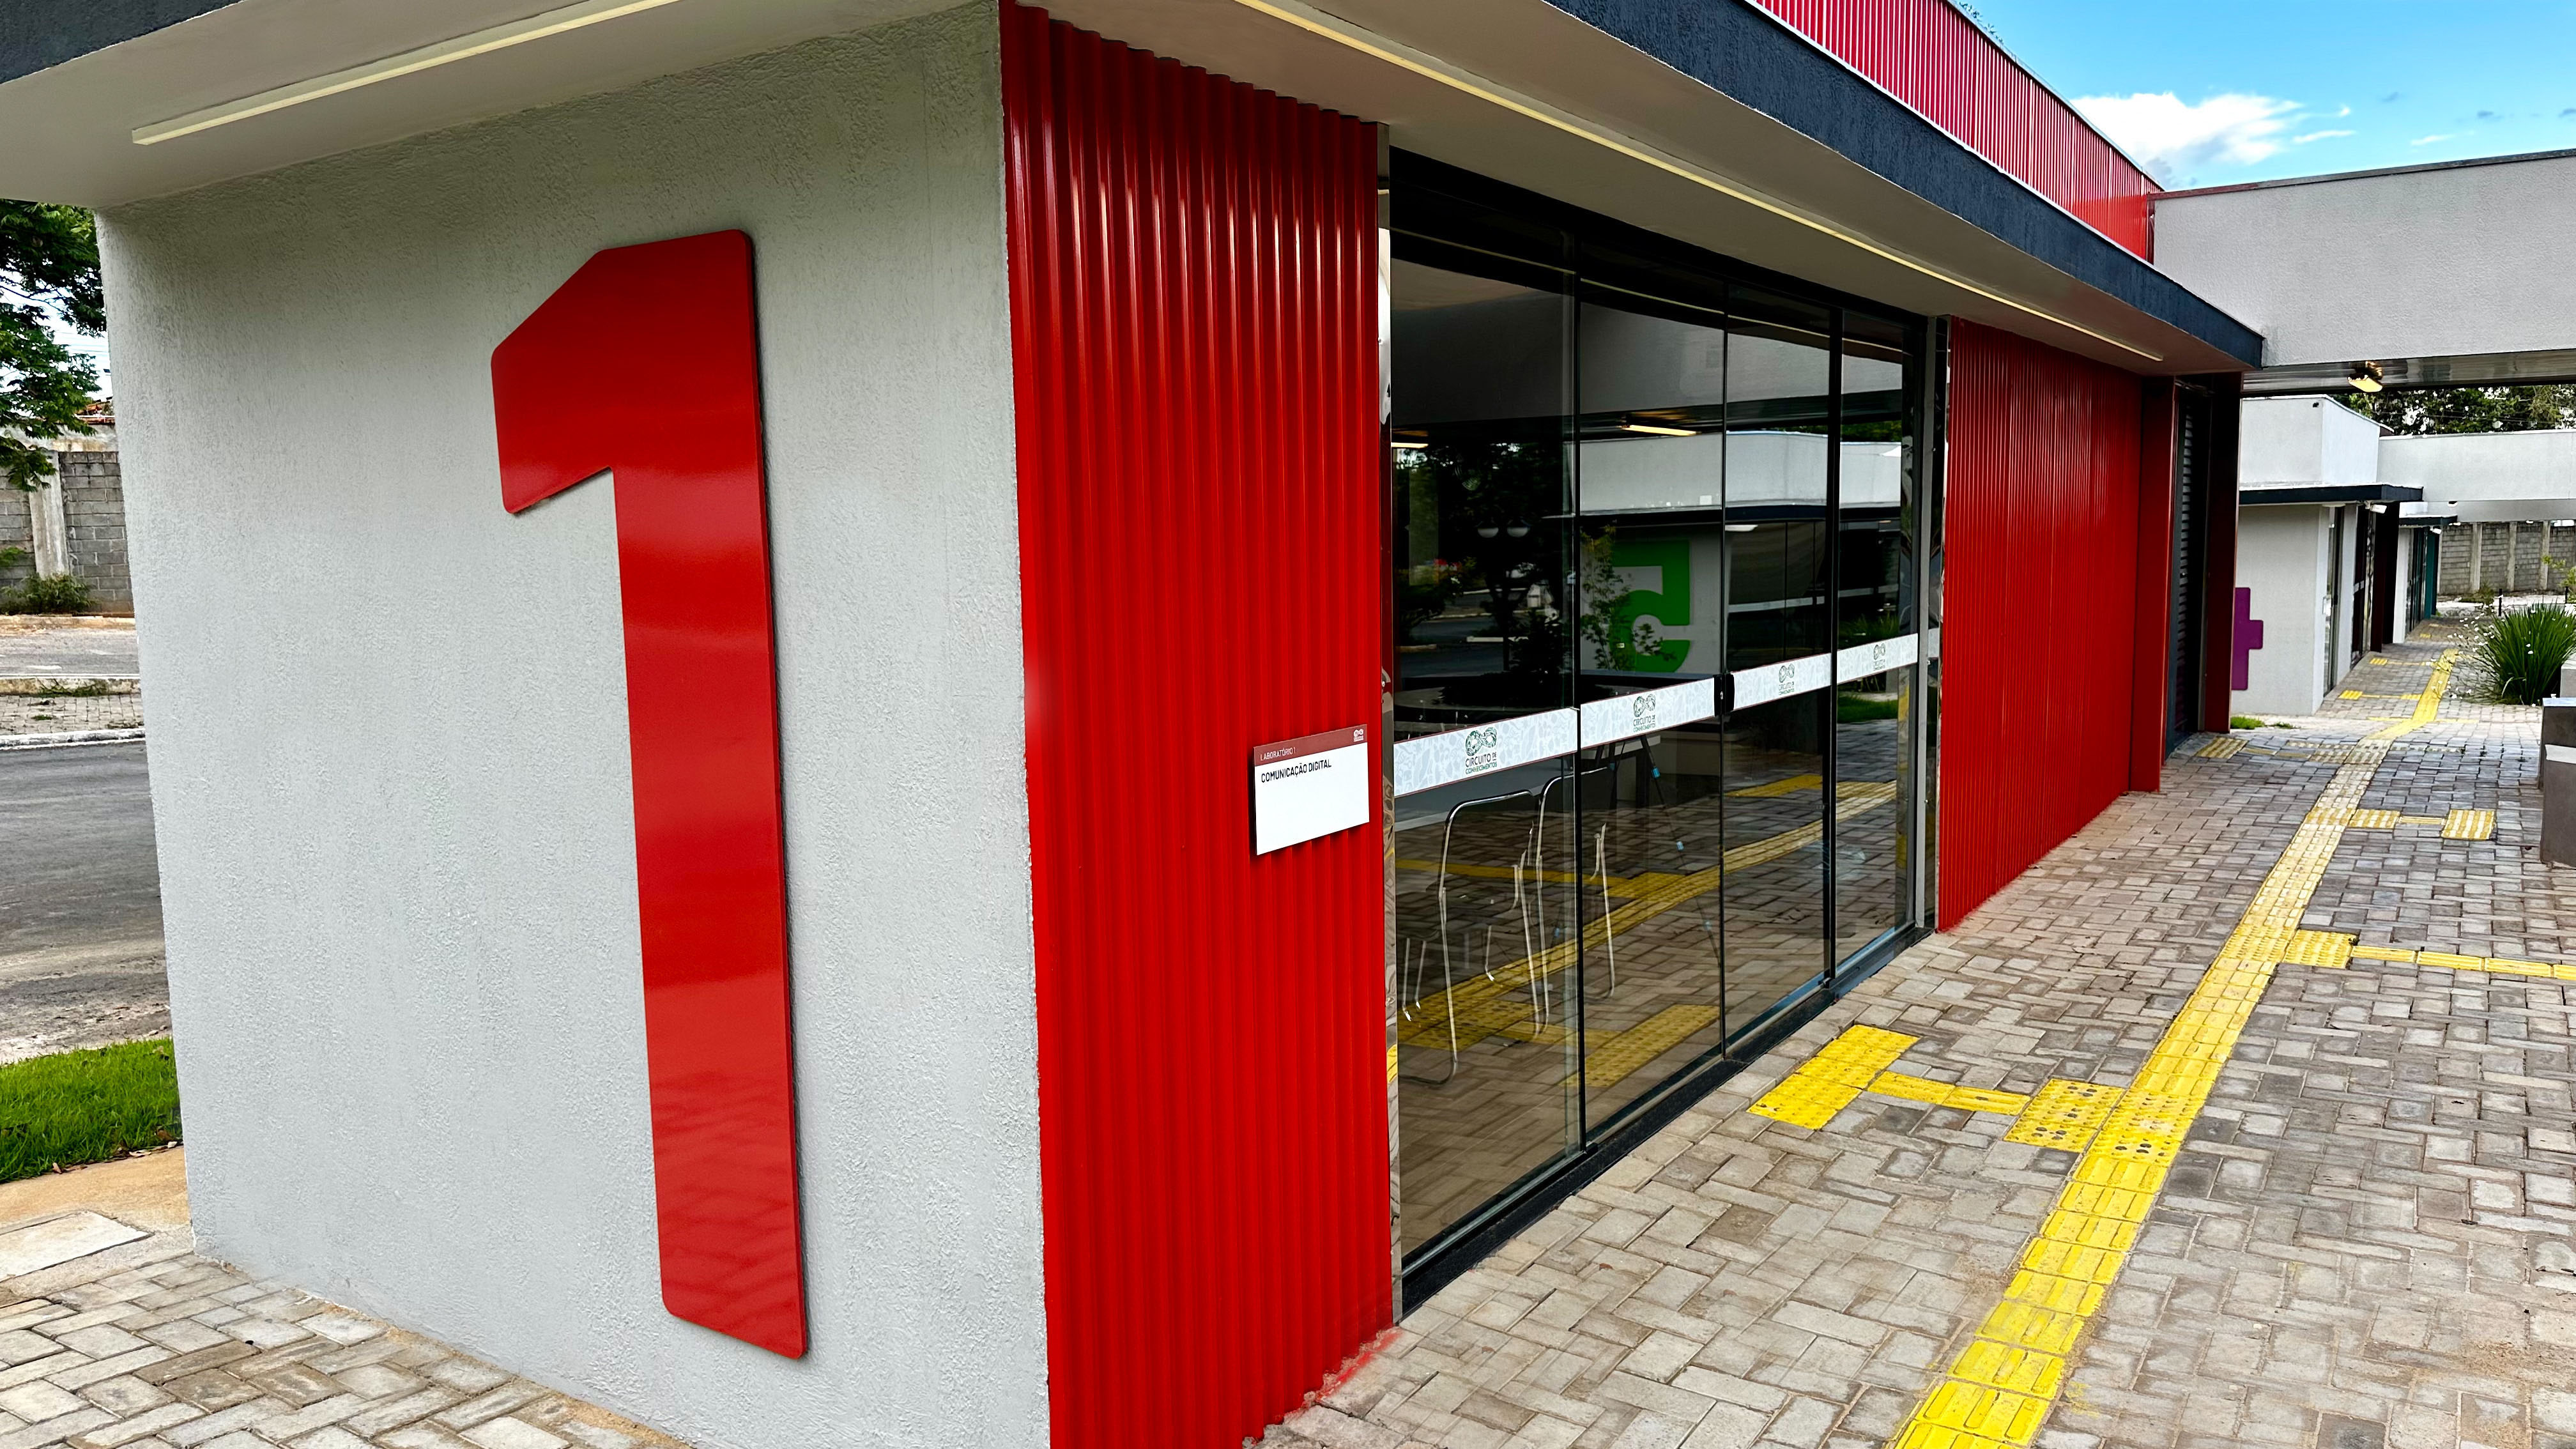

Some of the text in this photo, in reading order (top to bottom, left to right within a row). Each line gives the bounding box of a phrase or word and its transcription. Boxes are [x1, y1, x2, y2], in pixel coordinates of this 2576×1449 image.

[1261, 759, 1331, 783] COMUNICAÇÃO DIGITAL
[1466, 753, 1491, 767] CIRCUITO
[491, 229, 806, 1358] 1
